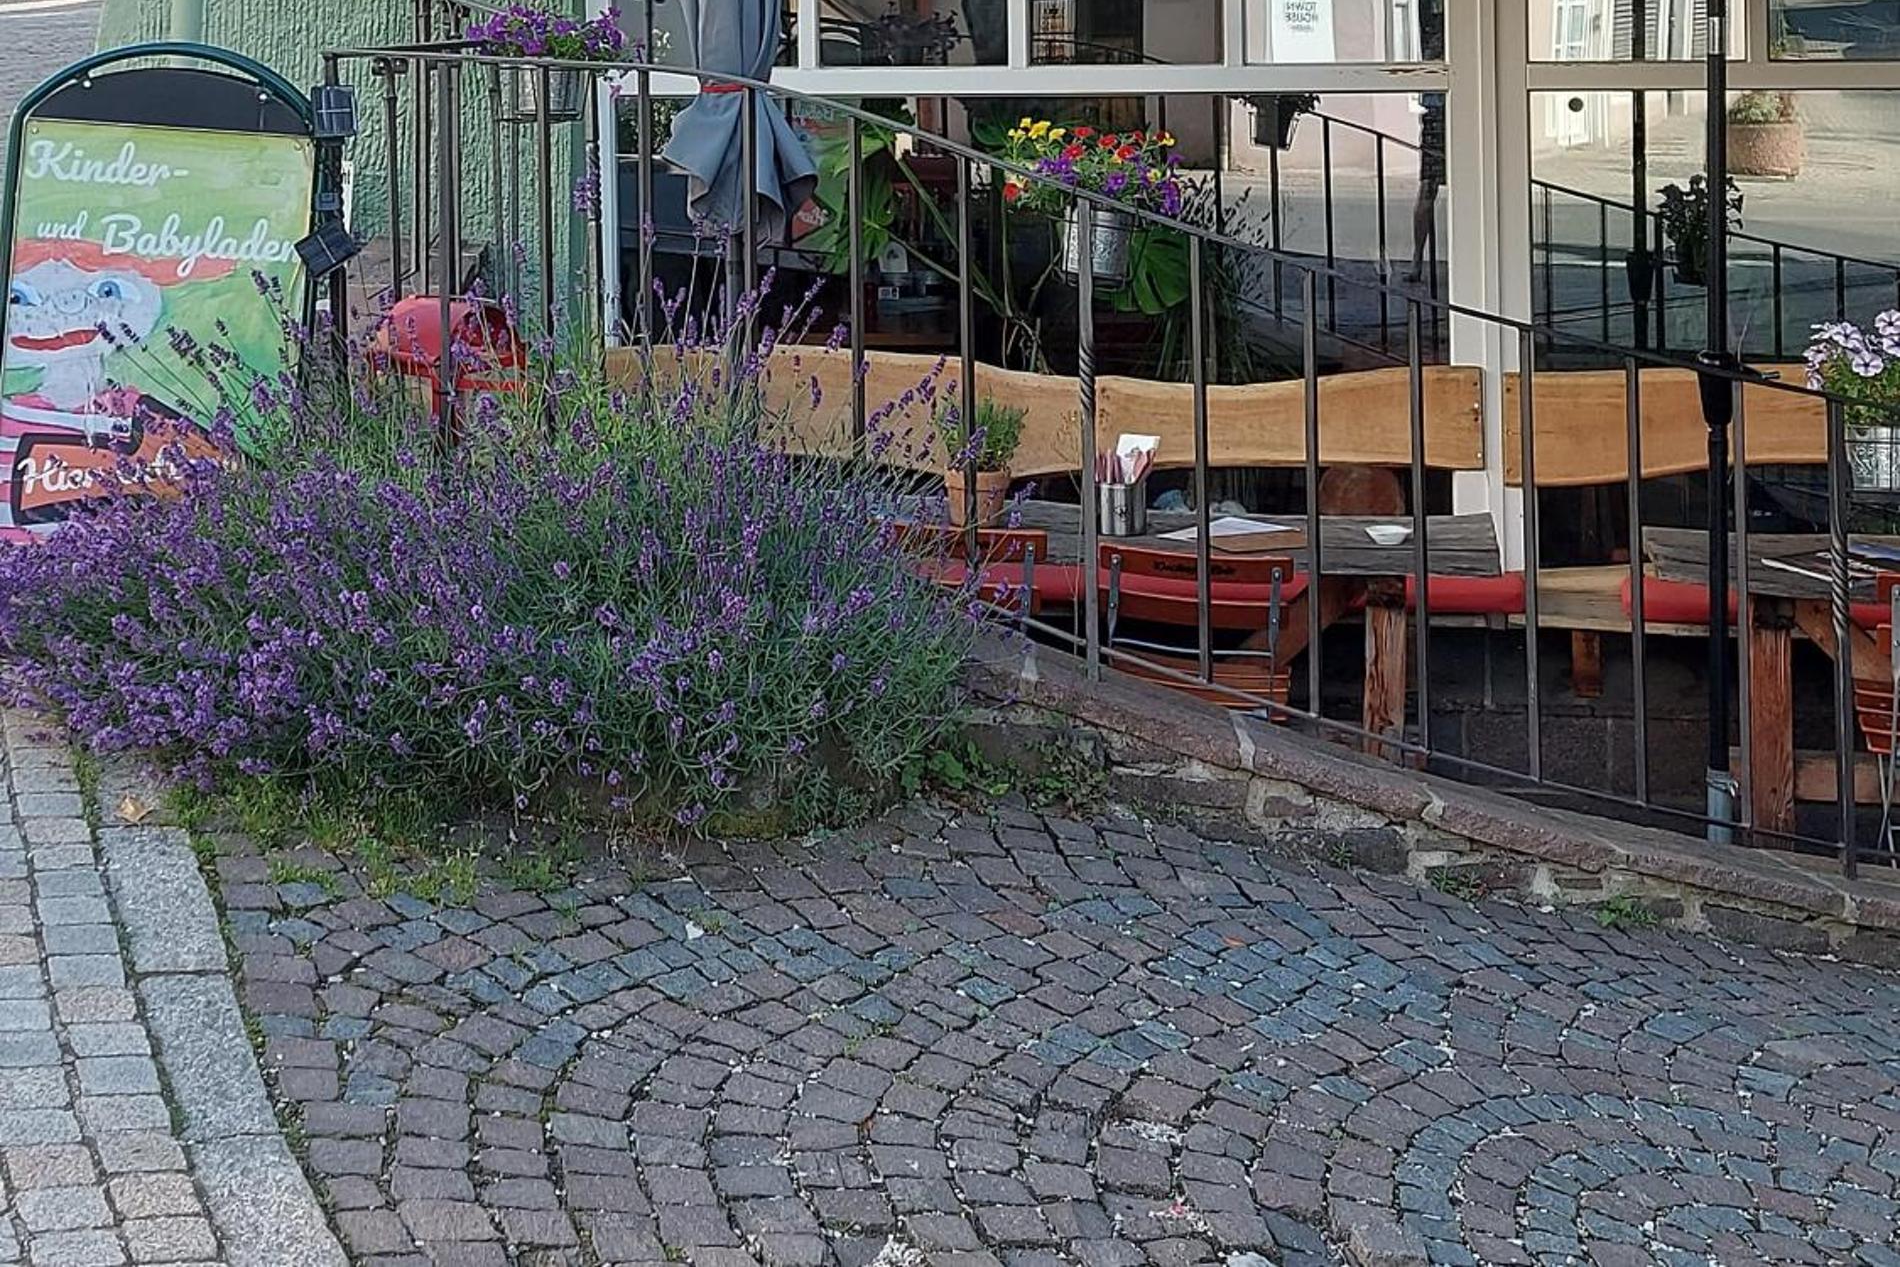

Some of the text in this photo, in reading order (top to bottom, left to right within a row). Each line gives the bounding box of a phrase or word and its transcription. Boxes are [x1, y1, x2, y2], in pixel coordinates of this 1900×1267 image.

[24, 139, 190, 186] Kinder-
[37, 210, 300, 276] und Babyladen
